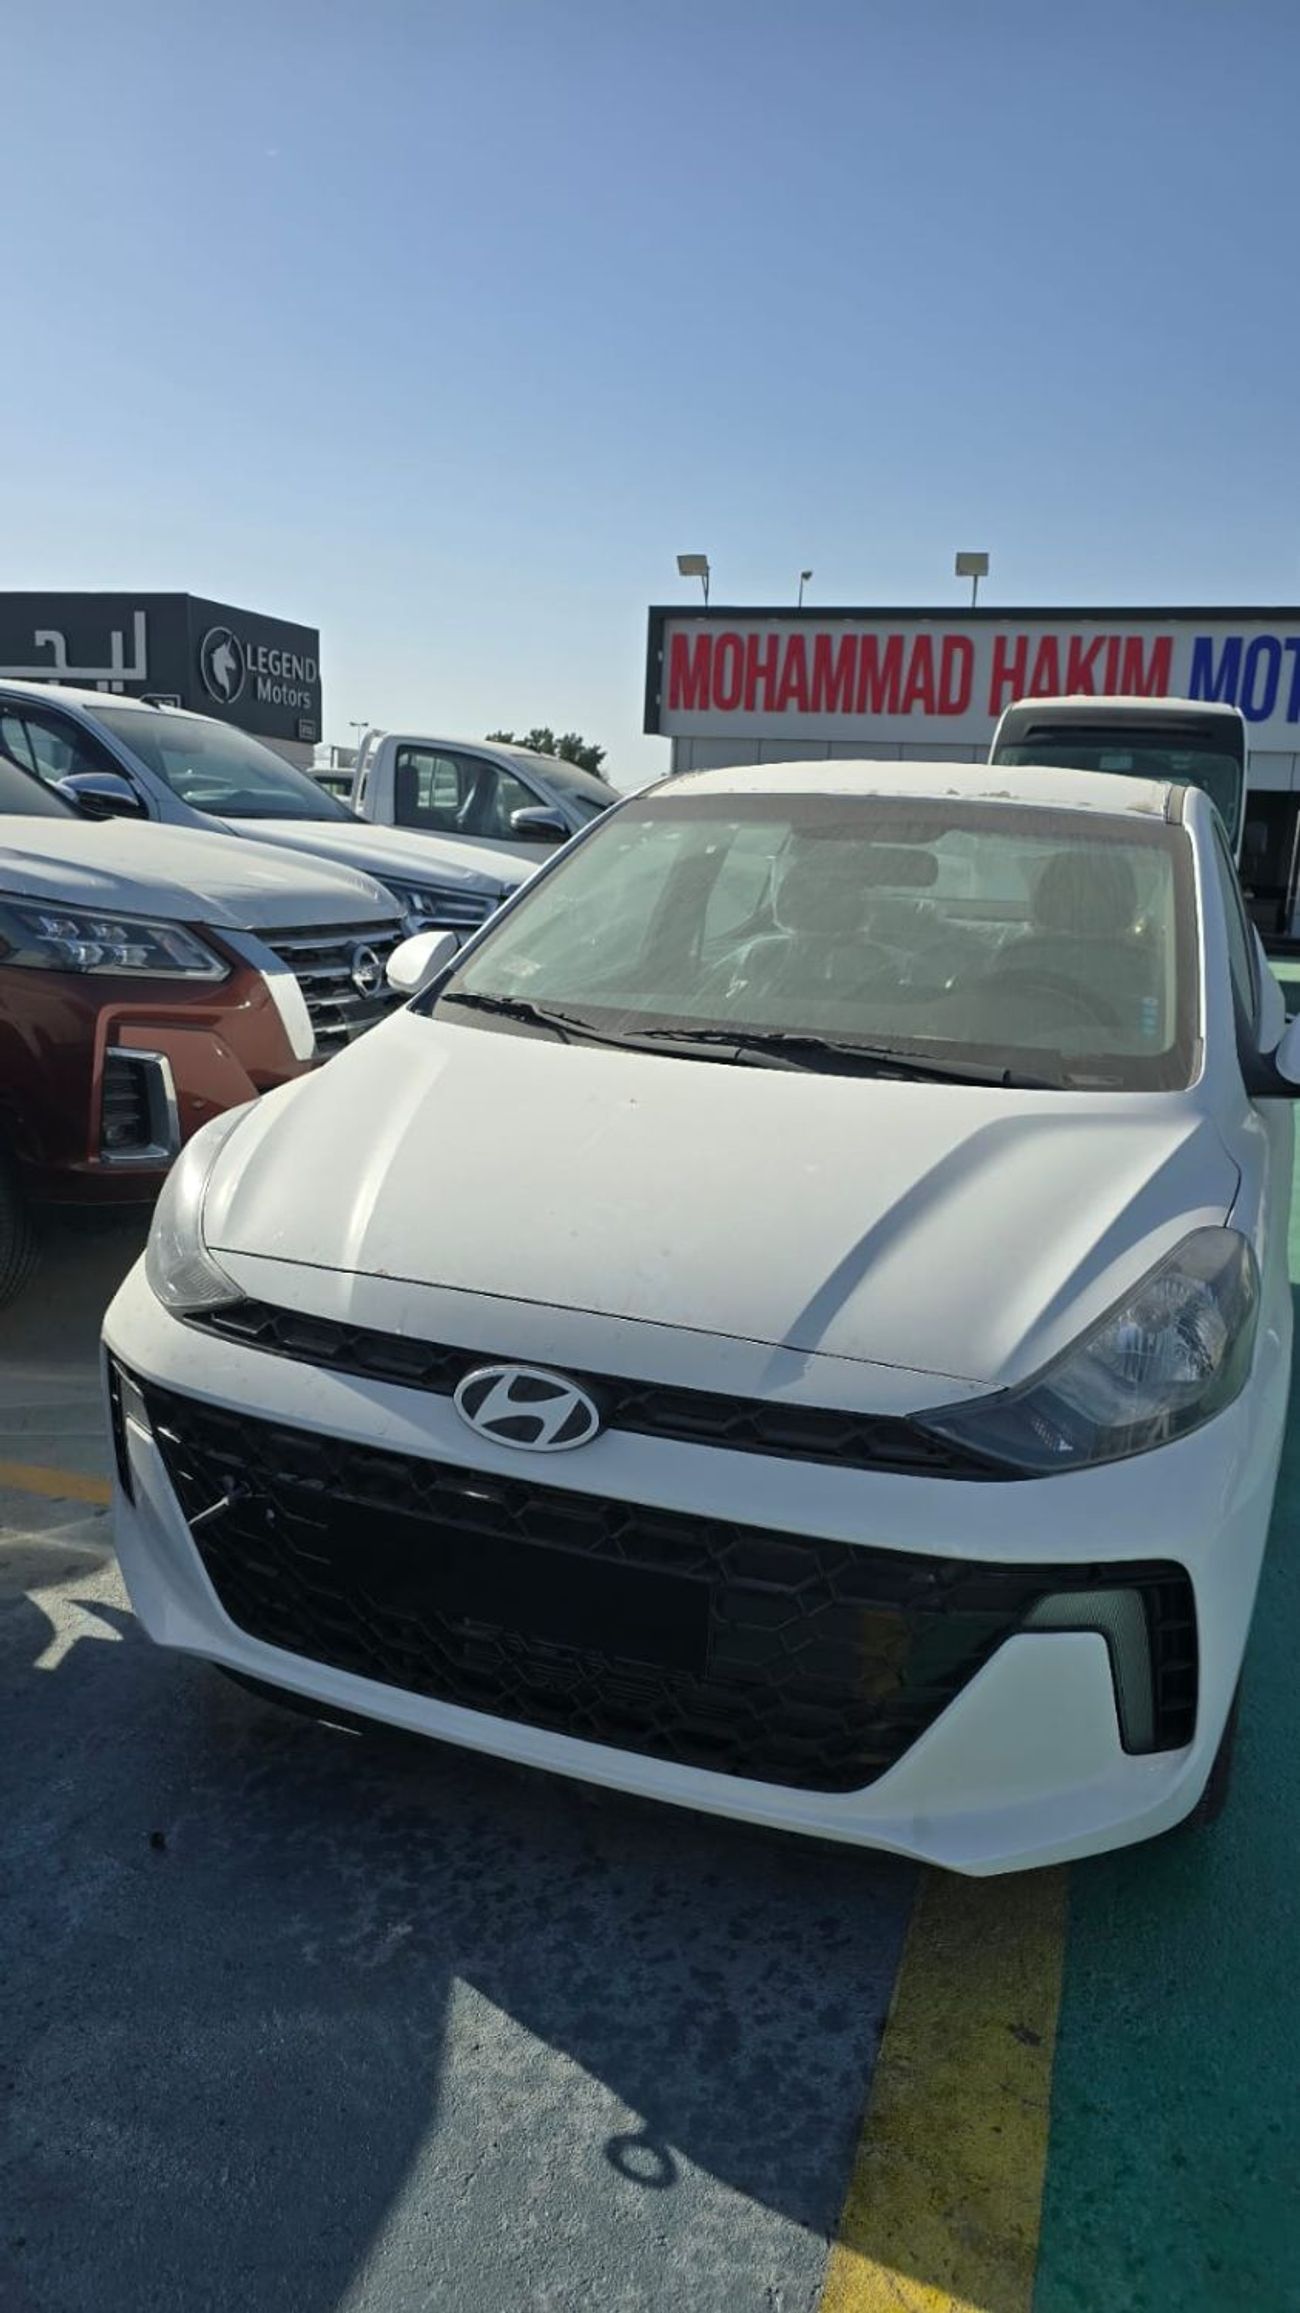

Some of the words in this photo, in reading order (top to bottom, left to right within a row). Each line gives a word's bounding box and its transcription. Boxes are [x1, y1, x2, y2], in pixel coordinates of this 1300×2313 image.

[246, 643, 317, 683] LEGEND
[668, 632, 974, 716] MOHAMMAD
[988, 634, 1174, 717] HAKIM
[257, 676, 312, 709] Motors
